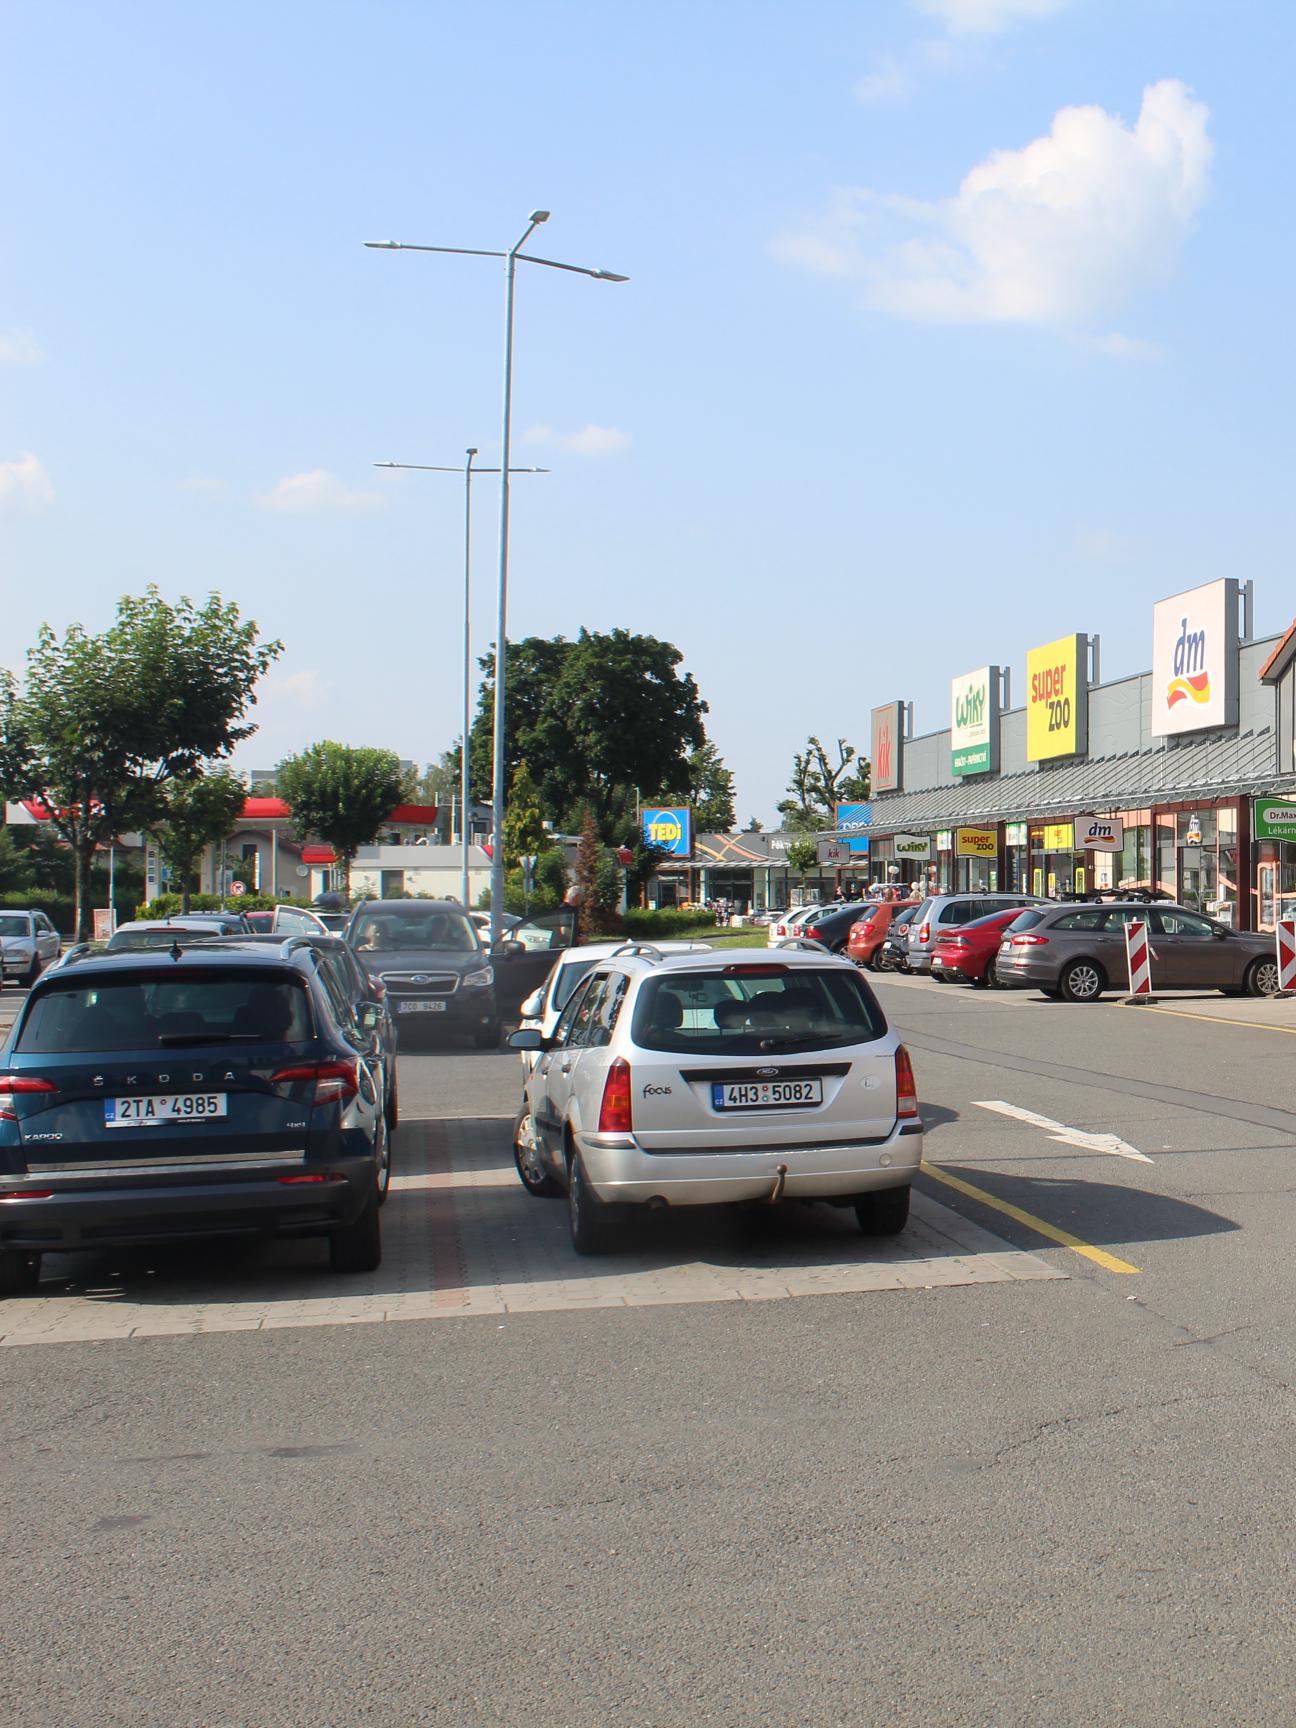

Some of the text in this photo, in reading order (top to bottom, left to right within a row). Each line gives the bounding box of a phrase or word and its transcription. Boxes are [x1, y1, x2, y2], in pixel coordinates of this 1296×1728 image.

[1173, 618, 1205, 677] dm
[1031, 664, 1067, 708] super
[876, 725, 891, 779] kik
[648, 823, 682, 841] TEDi
[1088, 822, 1112, 836] dm
[961, 835, 991, 845] super
[827, 847, 840, 859] kik
[92, 1071, 236, 1087] ŠKODA
[728, 1083, 814, 1104] 4H3 5082
[120, 1096, 218, 1119] 2TA 4985
